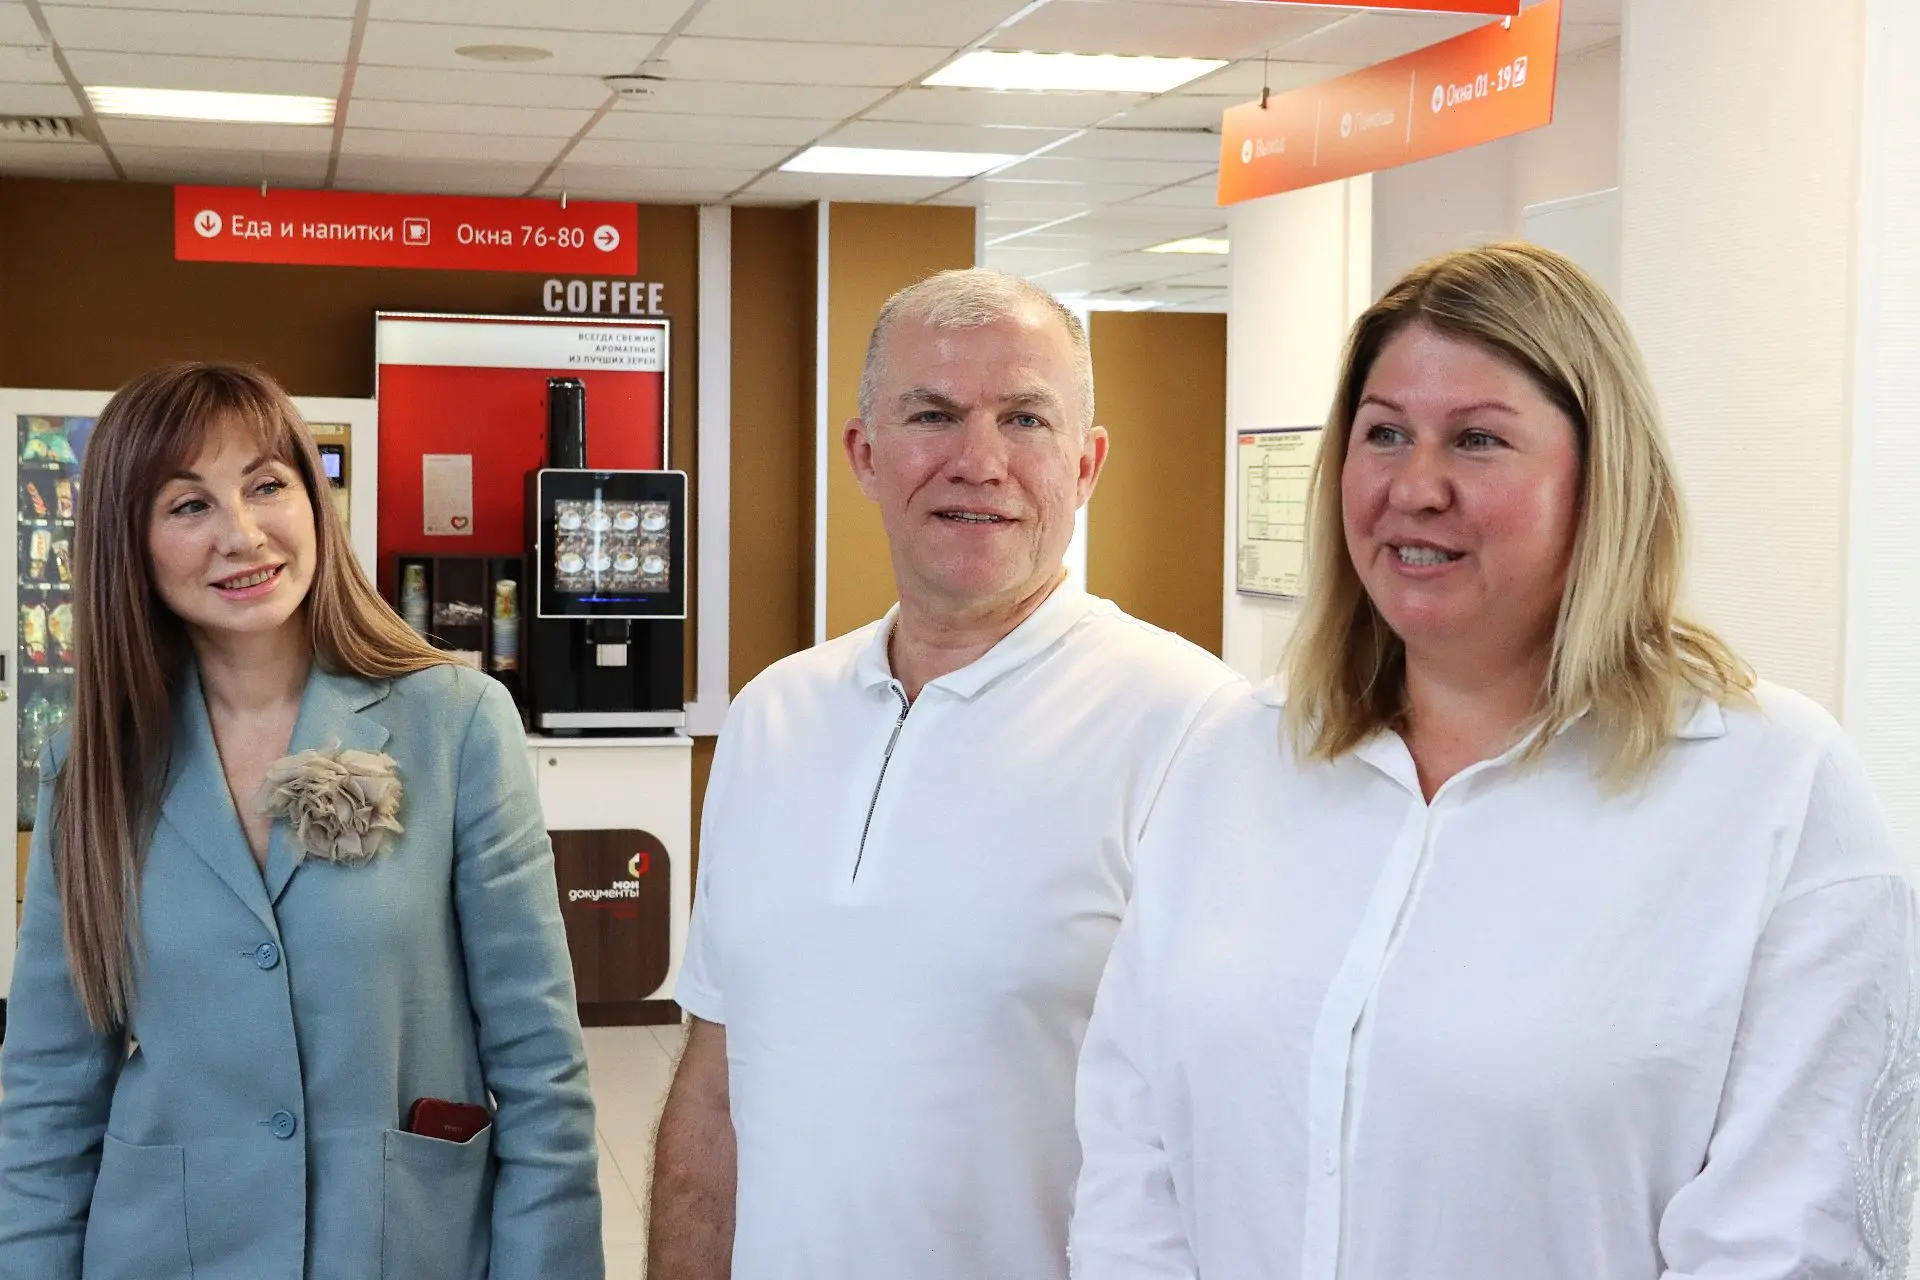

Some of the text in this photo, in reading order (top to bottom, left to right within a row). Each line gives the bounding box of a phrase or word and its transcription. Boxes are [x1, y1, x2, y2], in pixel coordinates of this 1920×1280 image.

[1446, 83, 1473, 107] Окна
[231, 214, 394, 242] Еда и напитки
[456, 222, 586, 249] Окна 76-80
[543, 278, 665, 316] COFFEE
[578, 333, 614, 342] ВСЕГДА
[569, 354, 582, 364] ИЗ
[583, 356, 624, 364] ЛУЧШИХ
[568, 889, 639, 901] документы
